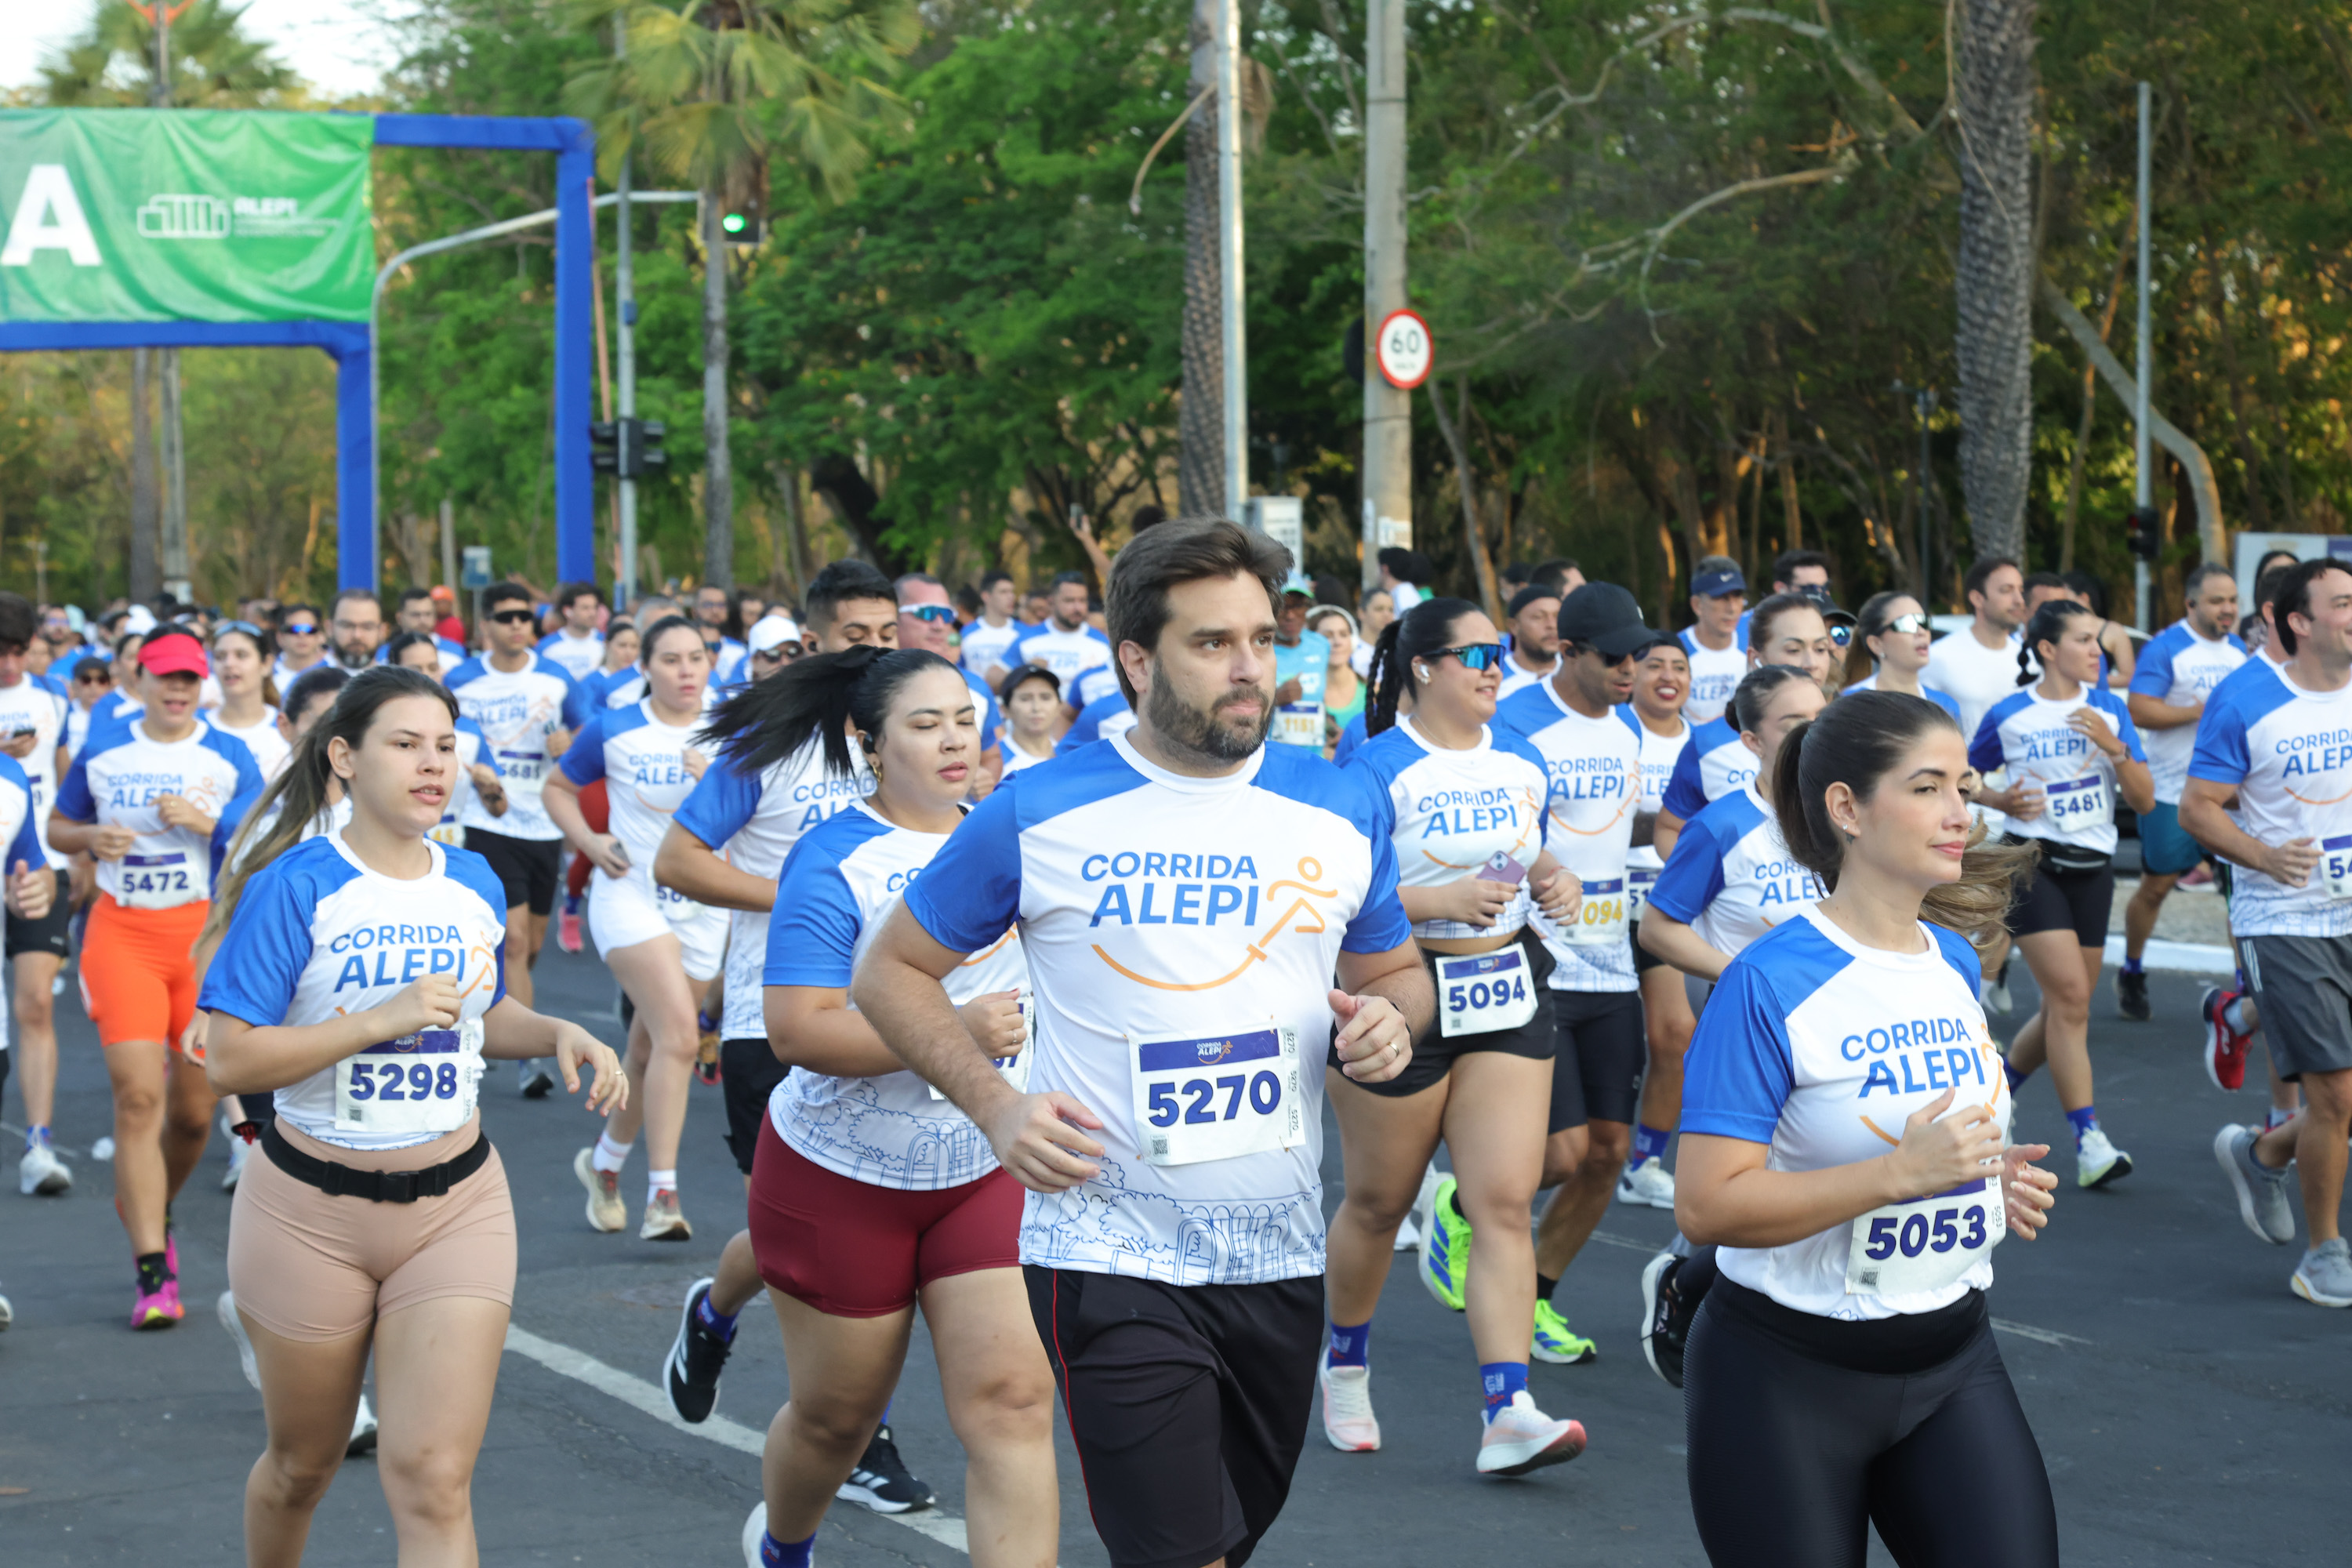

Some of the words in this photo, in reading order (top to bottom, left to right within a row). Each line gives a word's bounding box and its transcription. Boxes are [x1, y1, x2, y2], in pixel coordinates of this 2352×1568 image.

[1, 165, 102, 267] A
[1391, 330, 1421, 354] 60
[2020, 728, 2080, 745] CORRID
[2027, 739, 2087, 762] ALEPI
[629, 753, 680, 766] CORRI
[1547, 757, 1624, 775] CORRIDA
[1418, 788, 1510, 812] CORRIDA
[1551, 776, 1624, 800] ALEPI
[2053, 791, 2103, 817] 5481
[1421, 805, 1518, 839] ALEPI
[1081, 851, 1259, 881] CORRIDA
[123, 871, 189, 893] 5472
[1089, 883, 1259, 927] ALEPI
[1582, 898, 1623, 925] 094
[330, 924, 463, 953] CORRIDA
[334, 949, 466, 993] ALEPI
[1449, 975, 1526, 1012] 5094
[1196, 1041, 1222, 1050] CORRIDA
[1198, 1047, 1222, 1057] ALEPI
[1841, 1018, 1972, 1062] CORRIDA
[348, 1062, 457, 1101] 5298
[1857, 1047, 1986, 1099] ALEPI
[1148, 1070, 1282, 1127] 5270
[1865, 1205, 1987, 1261] 5053
